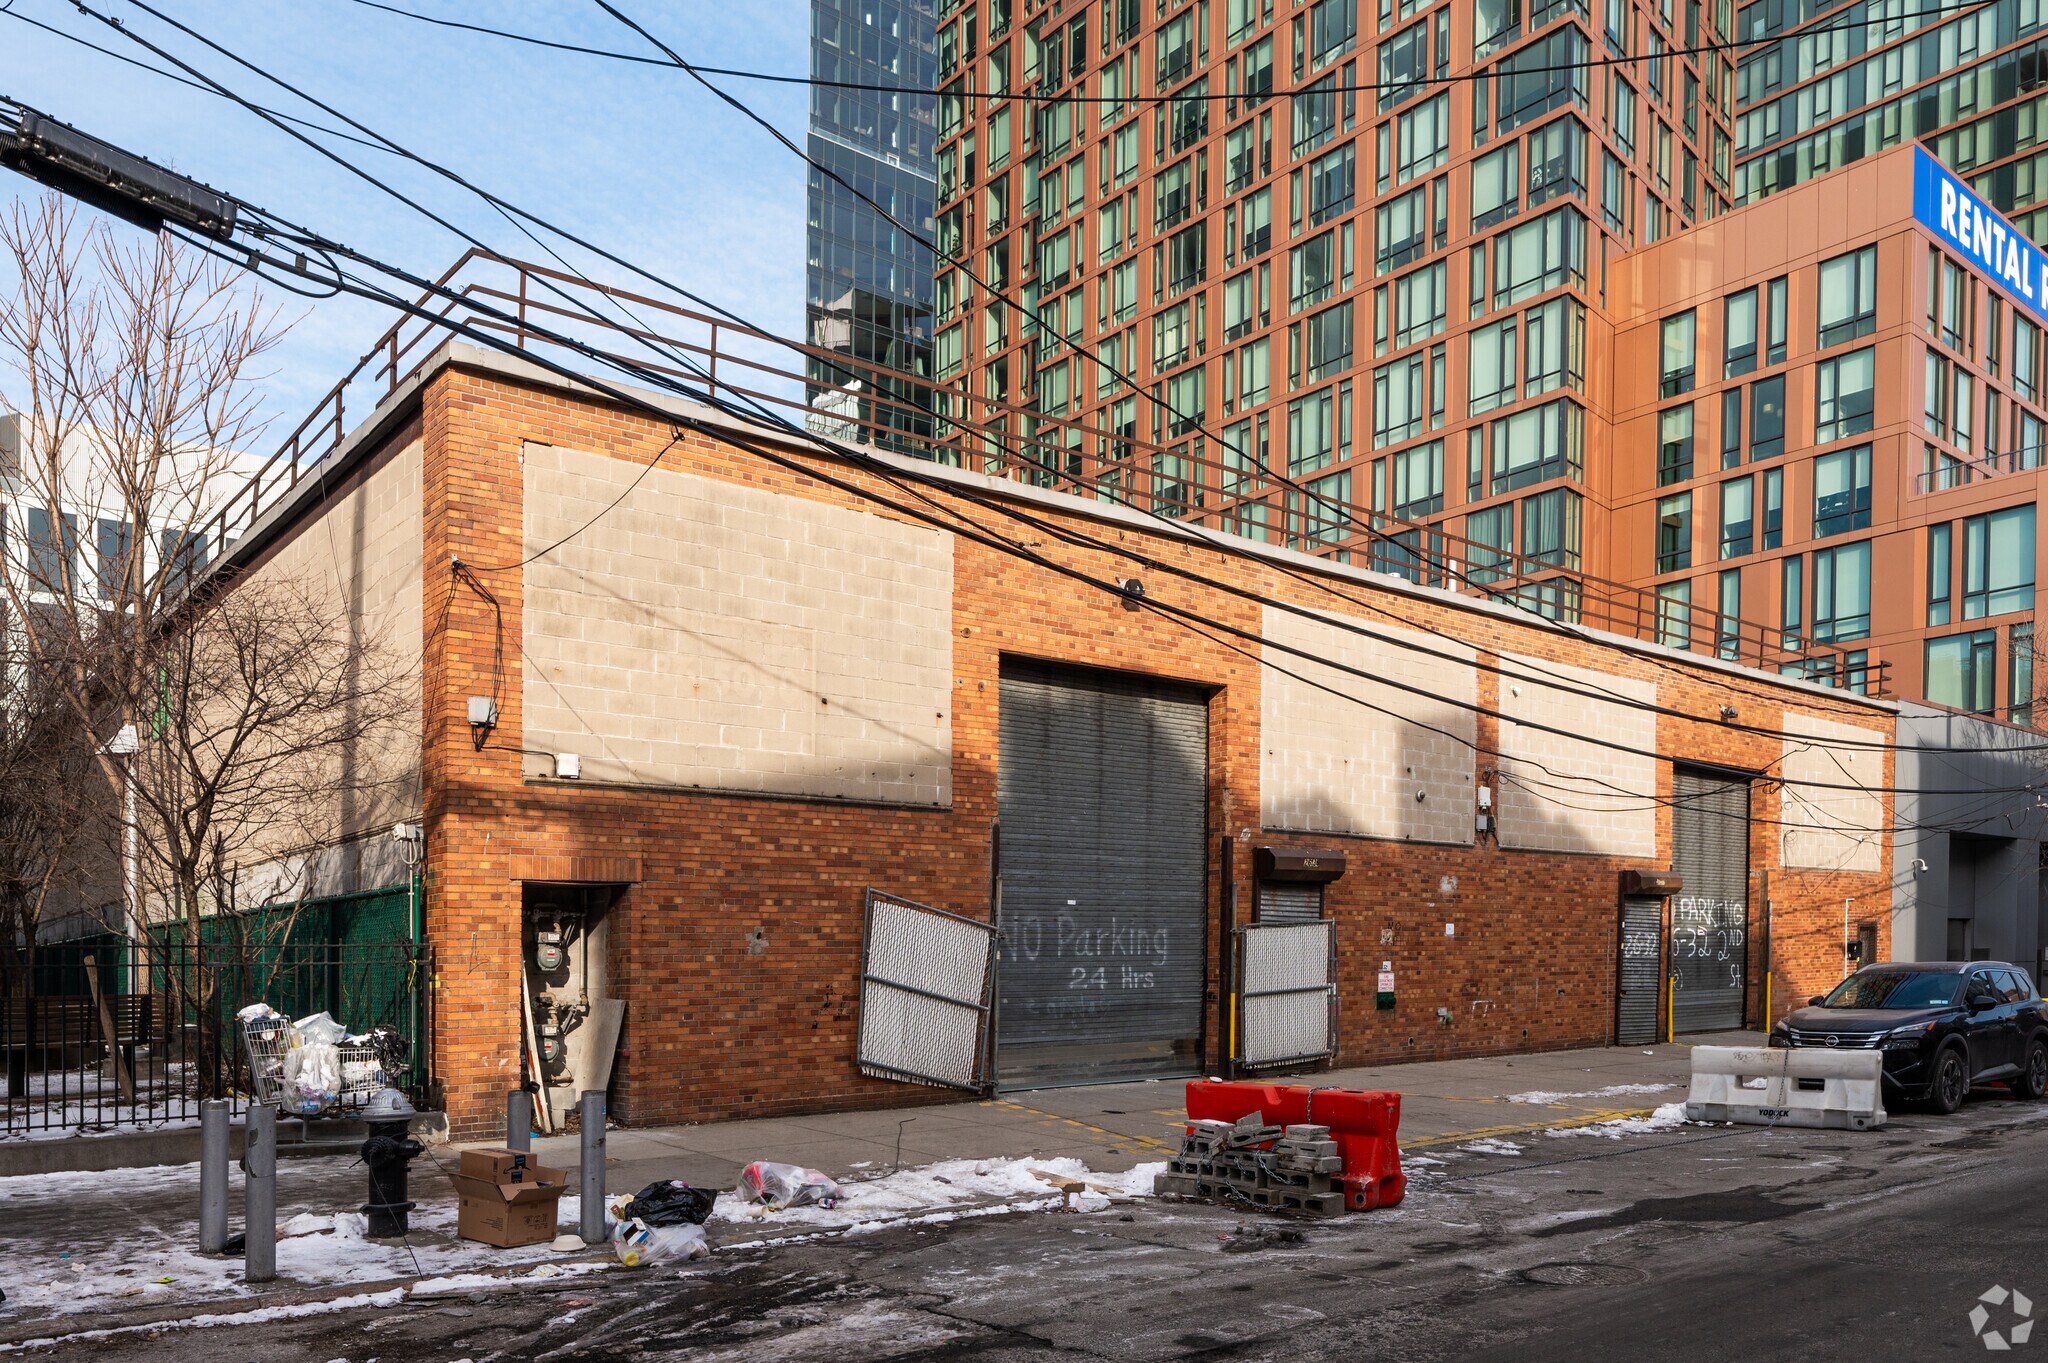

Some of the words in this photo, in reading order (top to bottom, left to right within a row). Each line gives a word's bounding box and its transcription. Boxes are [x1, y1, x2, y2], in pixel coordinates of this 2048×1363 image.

[1940, 177, 2033, 300] RENTAL
[1680, 896, 1744, 928] PARKING
[1057, 916, 1168, 966] Parking
[1068, 967, 1108, 989] 24
[1121, 964, 1155, 989] Hrs
